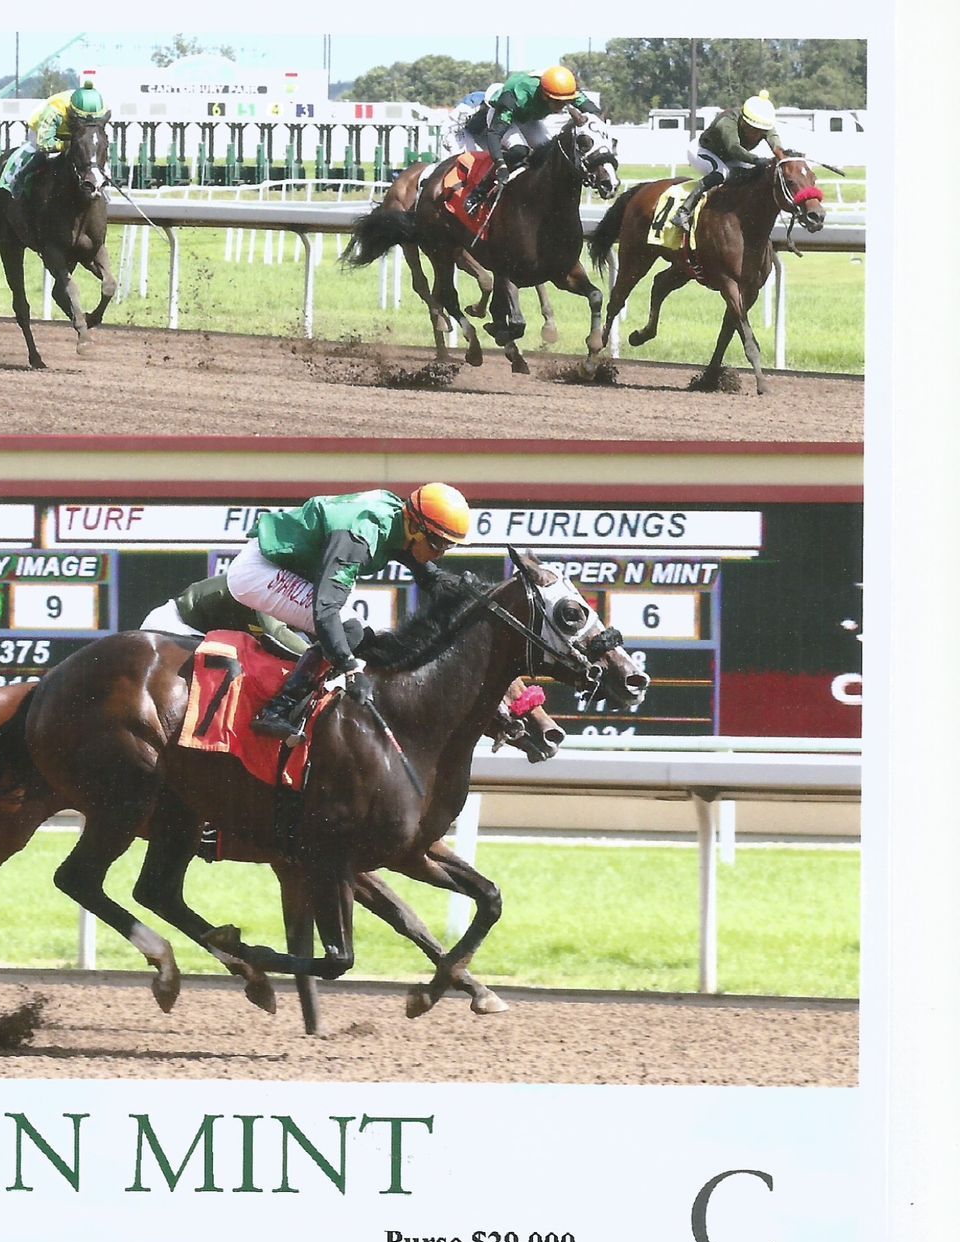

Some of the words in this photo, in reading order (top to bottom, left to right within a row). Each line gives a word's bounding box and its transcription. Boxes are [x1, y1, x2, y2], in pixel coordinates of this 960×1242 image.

[211, 102, 221, 117] 6
[66, 507, 145, 531] TURF
[477, 511, 493, 538] 6
[506, 511, 689, 539] FURLONGS
[15, 556, 98, 578] IMAGE
[624, 562, 645, 584] N
[651, 563, 718, 585] MINT
[46, 595, 62, 619] 9
[642, 603, 660, 629] 6
[193, 655, 242, 737] 7
